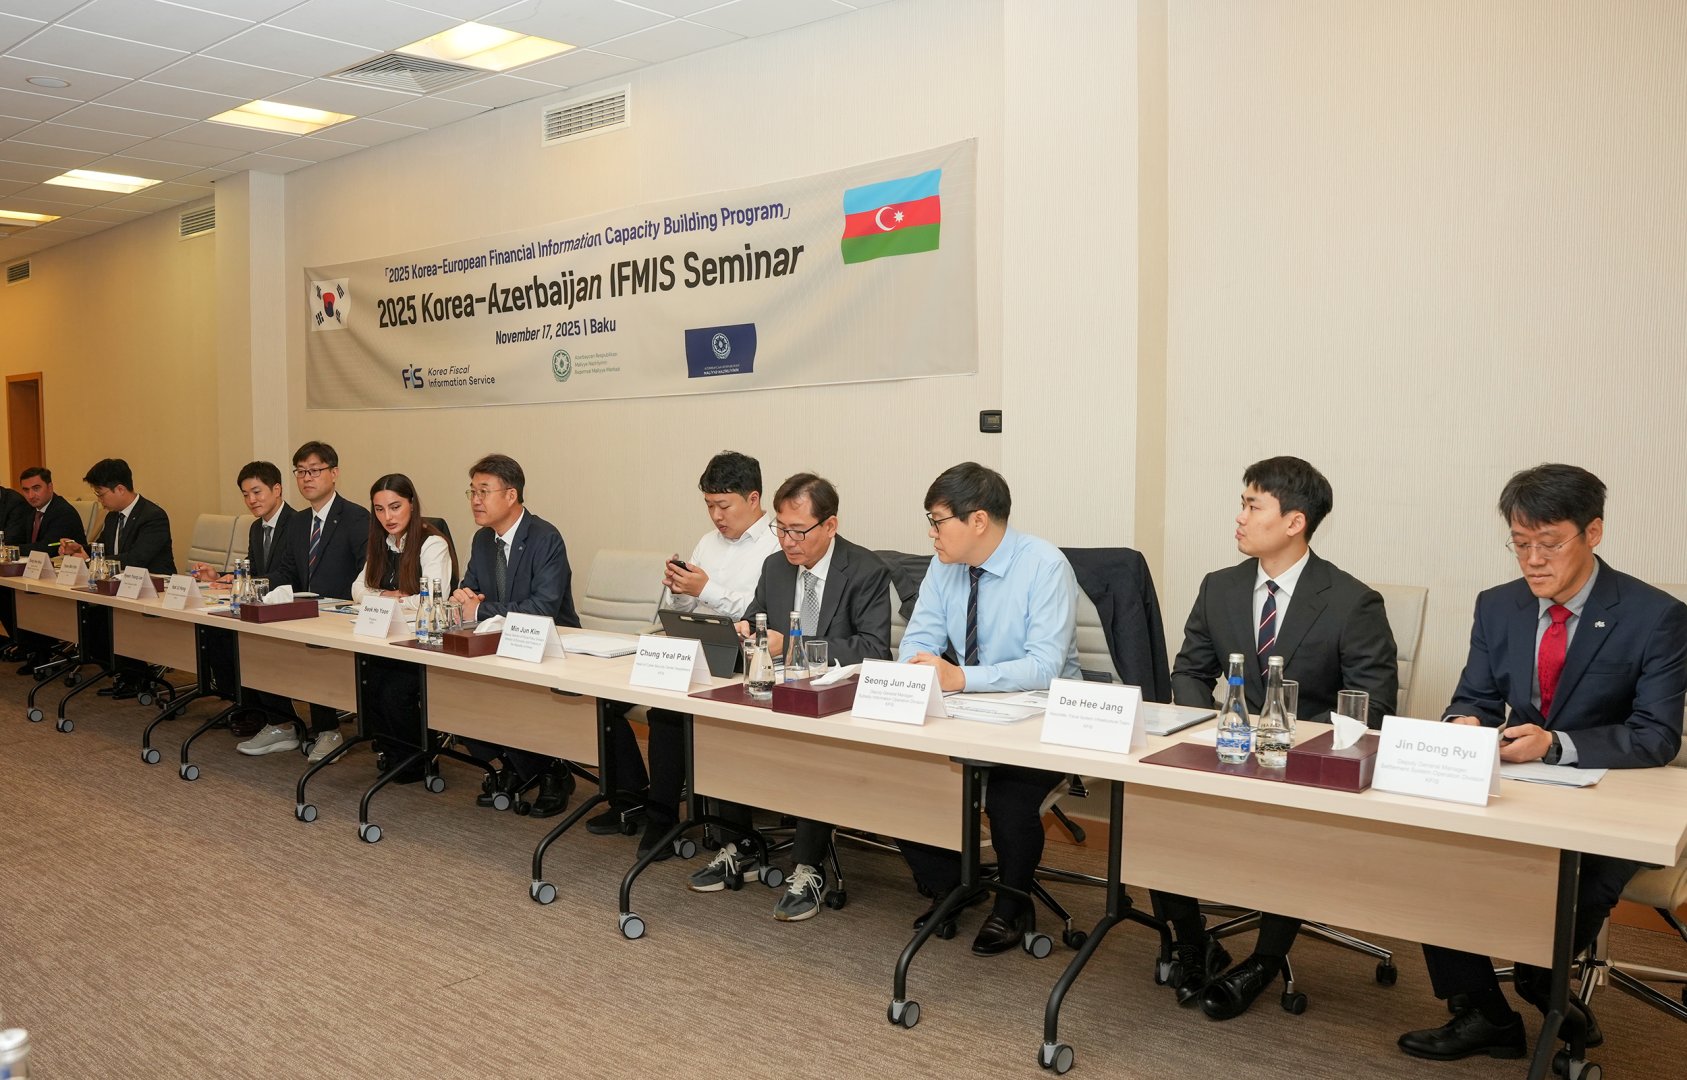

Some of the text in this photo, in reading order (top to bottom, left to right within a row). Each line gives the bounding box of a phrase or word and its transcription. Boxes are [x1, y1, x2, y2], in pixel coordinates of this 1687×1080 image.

[489, 243, 536, 266] Financial
[538, 232, 602, 258] Information
[605, 220, 660, 246] Capacity
[663, 211, 717, 235] Building
[377, 243, 804, 328] 2025 Korea-Azerbaijan IFMIS Seminar
[495, 327, 541, 345] November
[541, 324, 553, 341] 17,
[555, 320, 581, 338] 2025
[589, 317, 617, 334] Baku
[428, 365, 470, 377] Korea Fiscal
[428, 375, 496, 388] Information Service
[530, 628, 541, 636] Kim
[639, 648, 692, 662] Chung Yeal Park
[864, 675, 927, 692] Seong Jun Jang
[1059, 696, 1124, 715] Dae Hee Jang
[1395, 739, 1477, 760] Jin Dong Ryu
